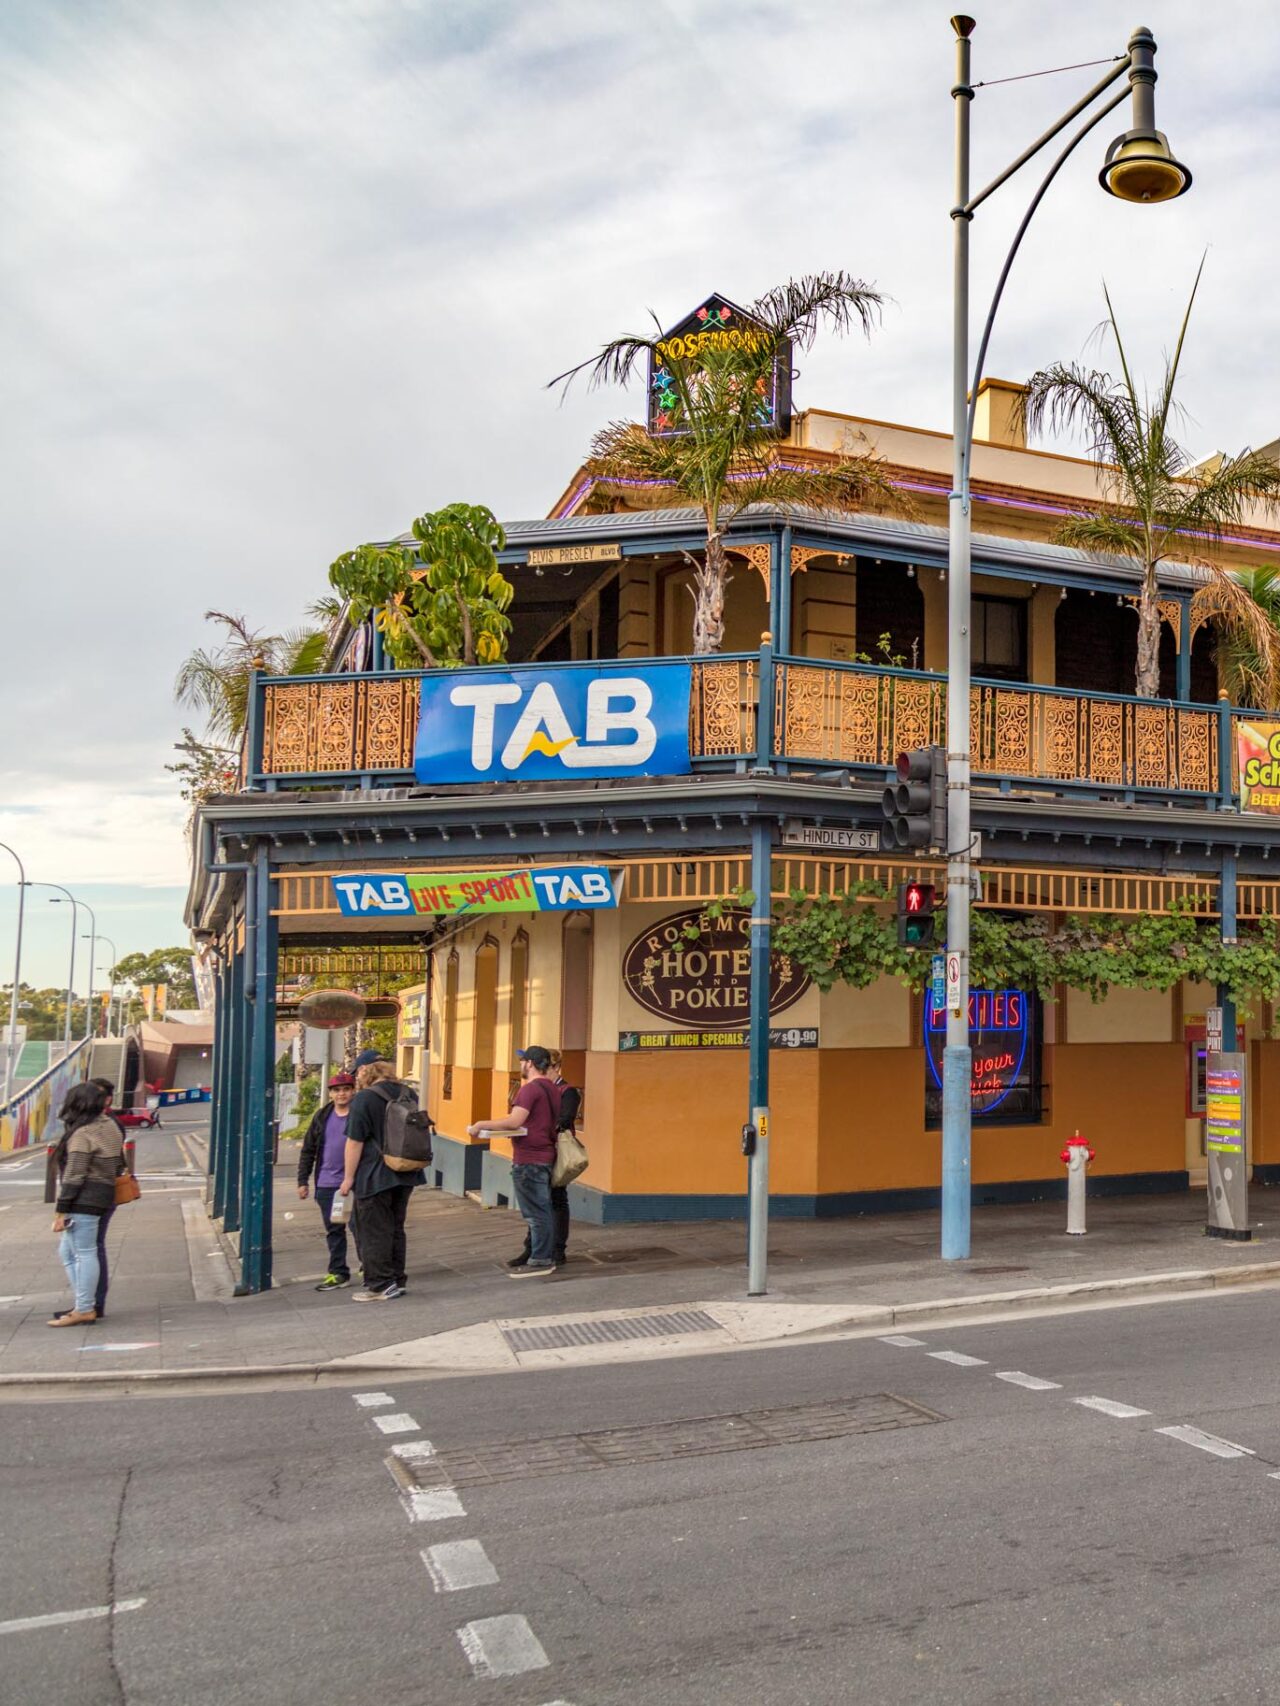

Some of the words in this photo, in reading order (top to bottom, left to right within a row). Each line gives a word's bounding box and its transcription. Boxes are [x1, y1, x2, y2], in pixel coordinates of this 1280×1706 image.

[532, 549, 554, 563] ELVIS
[559, 547, 595, 561] PRESLEY
[600, 547, 616, 556] BLVD
[450, 678, 657, 771] TAB
[803, 829, 853, 845] HINDLEY
[860, 833, 874, 846] ST
[336, 881, 410, 911] TAB
[408, 885, 452, 913] LIVE
[460, 872, 533, 905] SPORT
[534, 873, 611, 905] TAB
[646, 914, 751, 953] ROSEMO
[661, 949, 752, 979] HOTE
[696, 977, 738, 985] AND
[669, 986, 752, 1009] POKIE
[932, 996, 1019, 1026] PKIES
[954, 1010, 960, 1018] 9
[640, 1034, 667, 1047] GREAT
[670, 1033, 699, 1047] LUNCH
[701, 1032, 743, 1047] SPECIALS
[974, 1054, 1014, 1078] your
